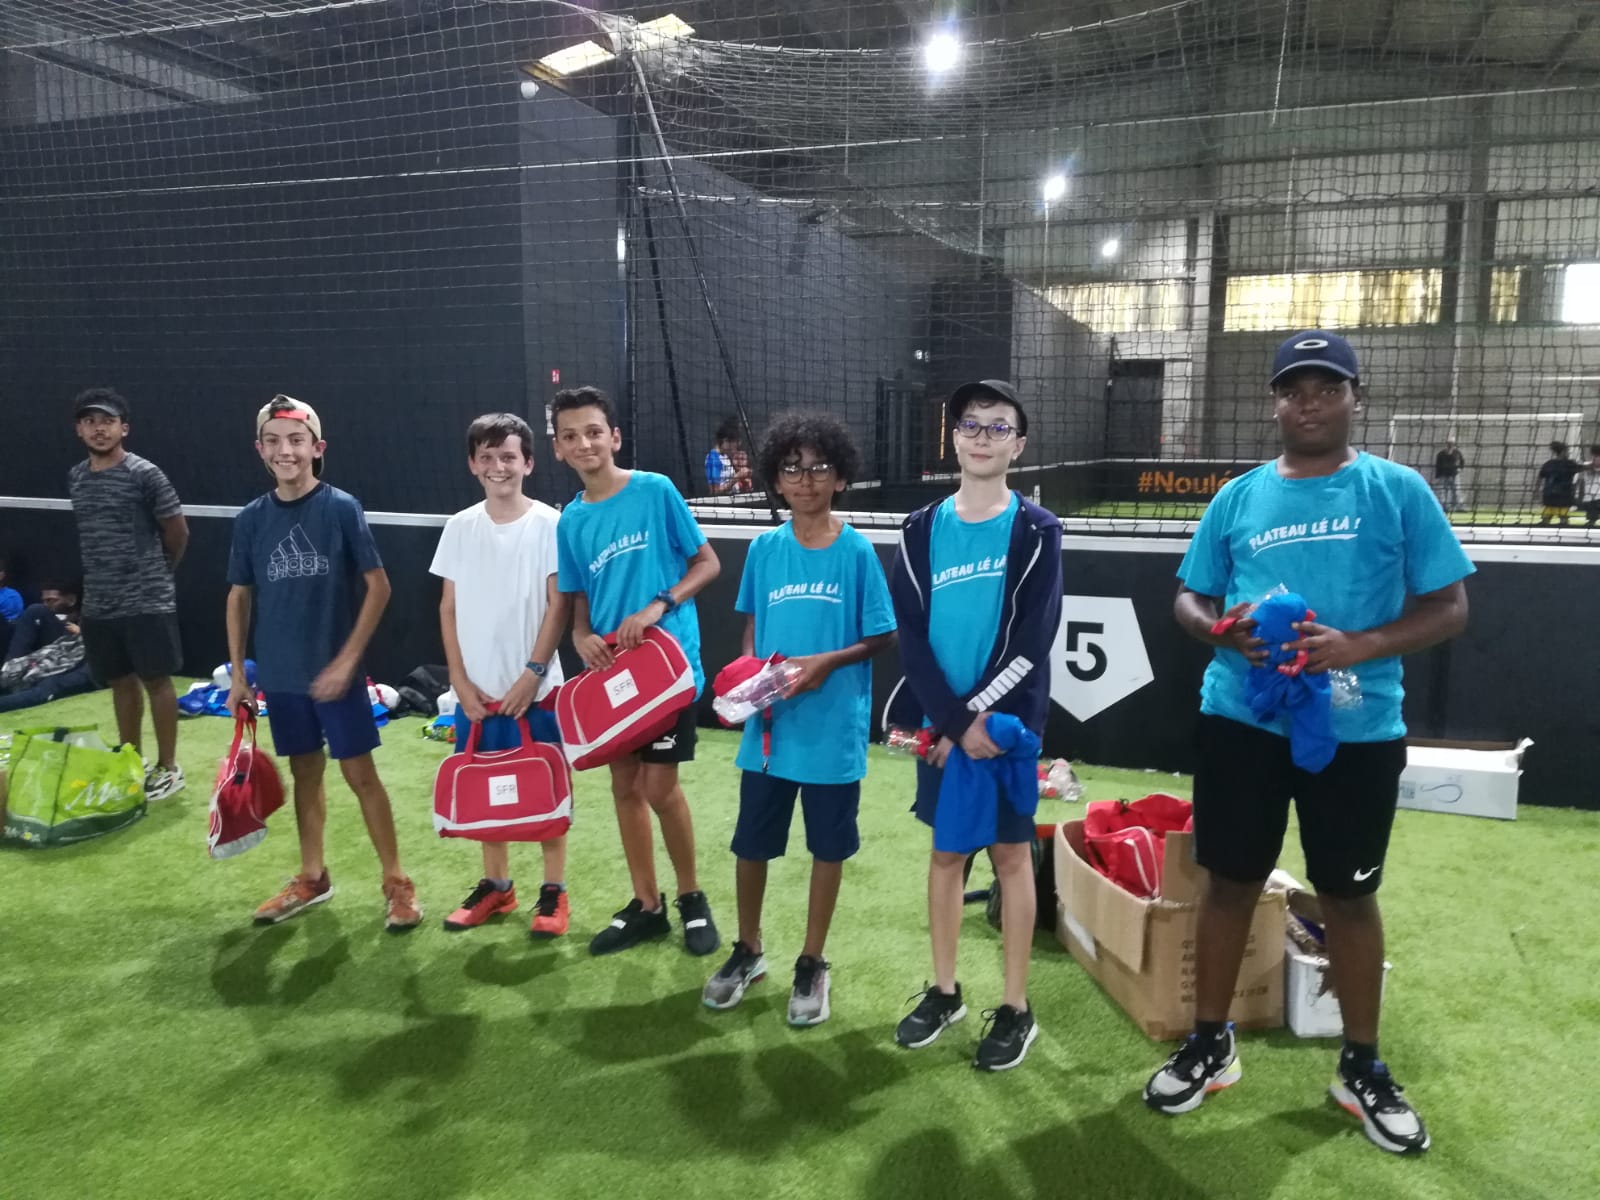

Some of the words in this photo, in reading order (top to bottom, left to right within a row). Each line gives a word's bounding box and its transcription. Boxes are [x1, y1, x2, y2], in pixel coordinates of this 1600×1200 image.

[1248, 523, 1307, 550] PLATEAU
[1311, 517, 1328, 534] LÉ
[932, 562, 974, 585] LATEAU
[977, 556, 991, 571] LÉ
[809, 580, 824, 594] LÉ
[1065, 620, 1108, 682] 5
